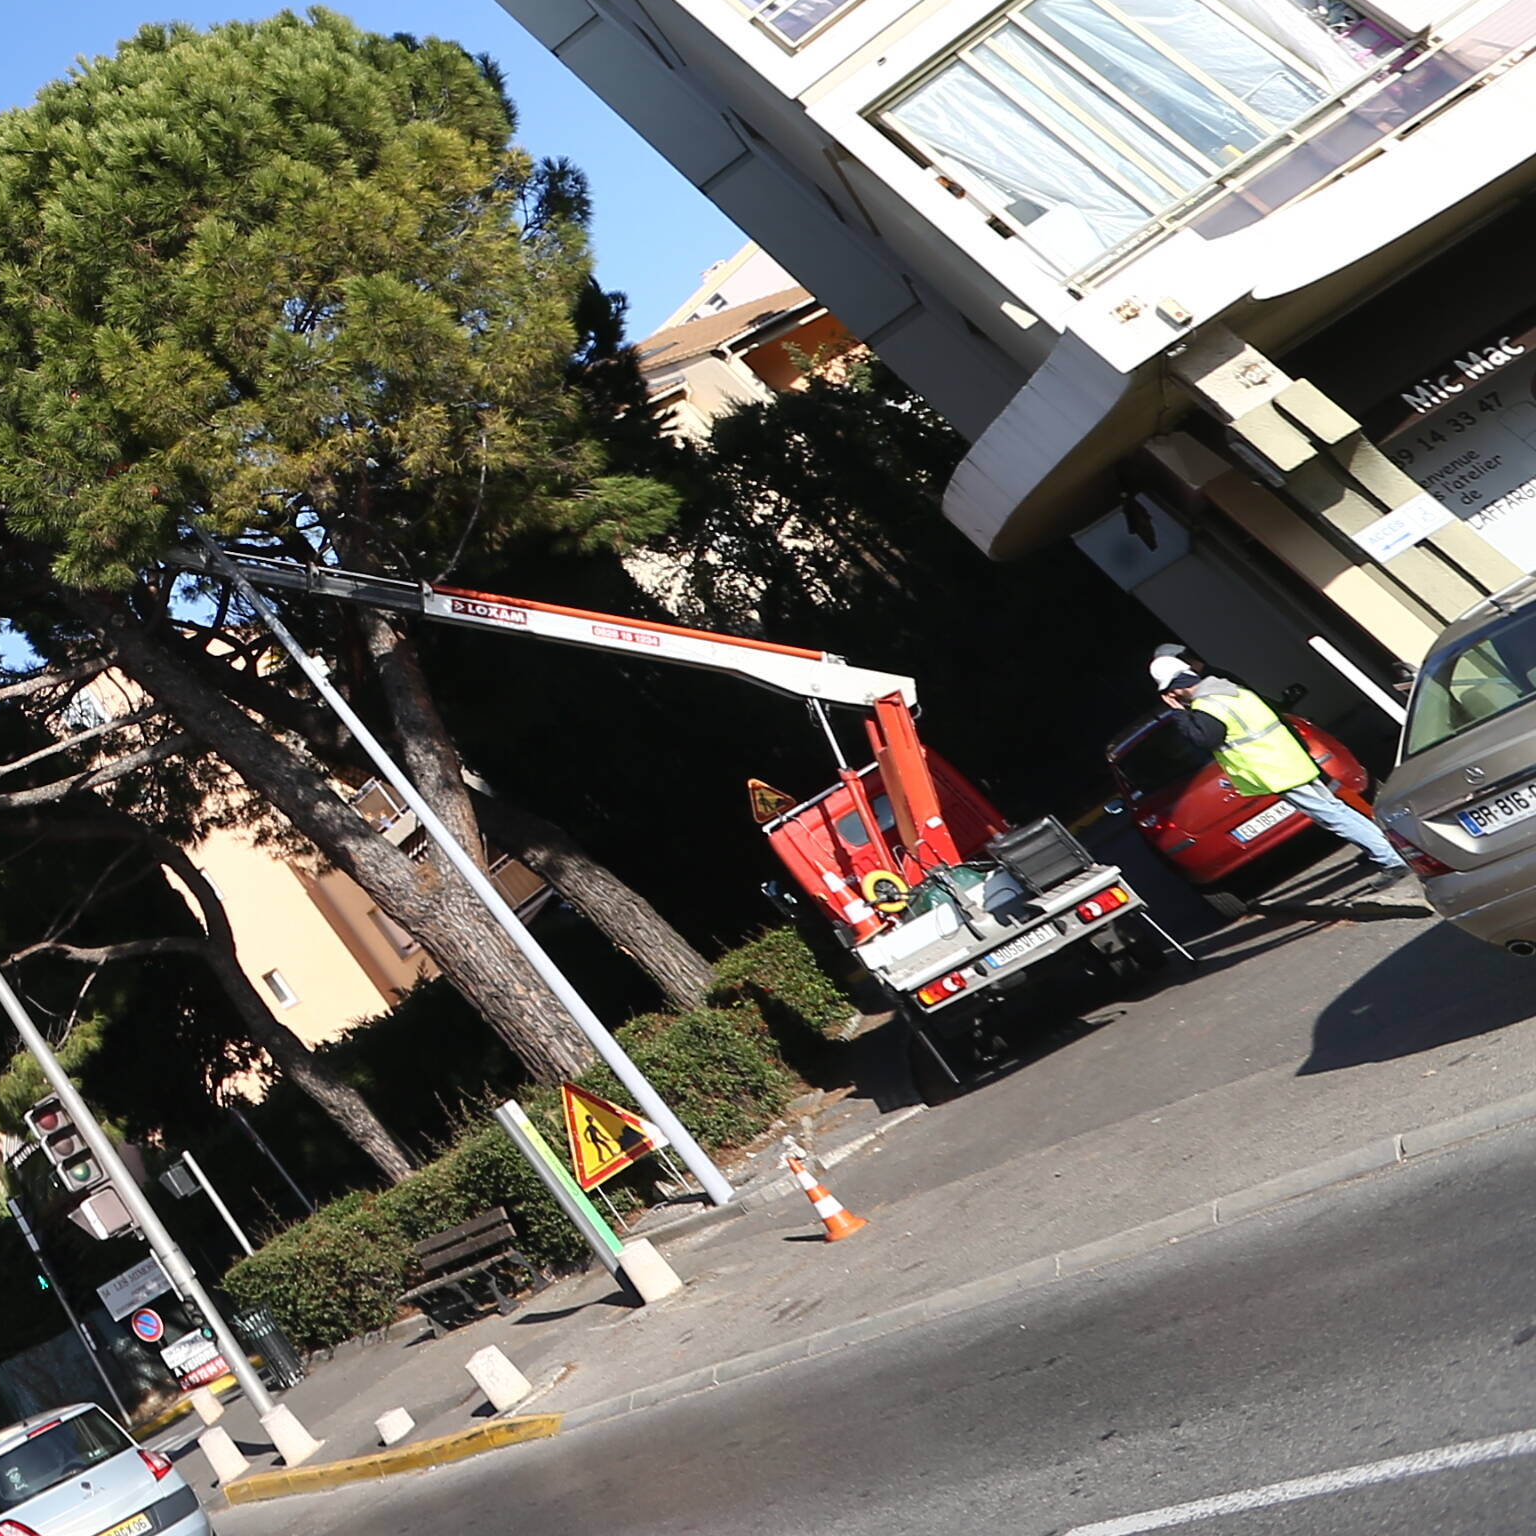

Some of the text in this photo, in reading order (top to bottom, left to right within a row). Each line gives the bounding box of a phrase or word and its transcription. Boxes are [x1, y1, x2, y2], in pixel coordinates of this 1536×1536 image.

[1401, 336, 1526, 414] Mic Mac
[1417, 429, 1448, 452] 14
[1446, 411, 1477, 433] 33
[1478, 390, 1504, 413] 47
[1460, 488, 1484, 506] de
[466, 603, 526, 623] LOXAM
